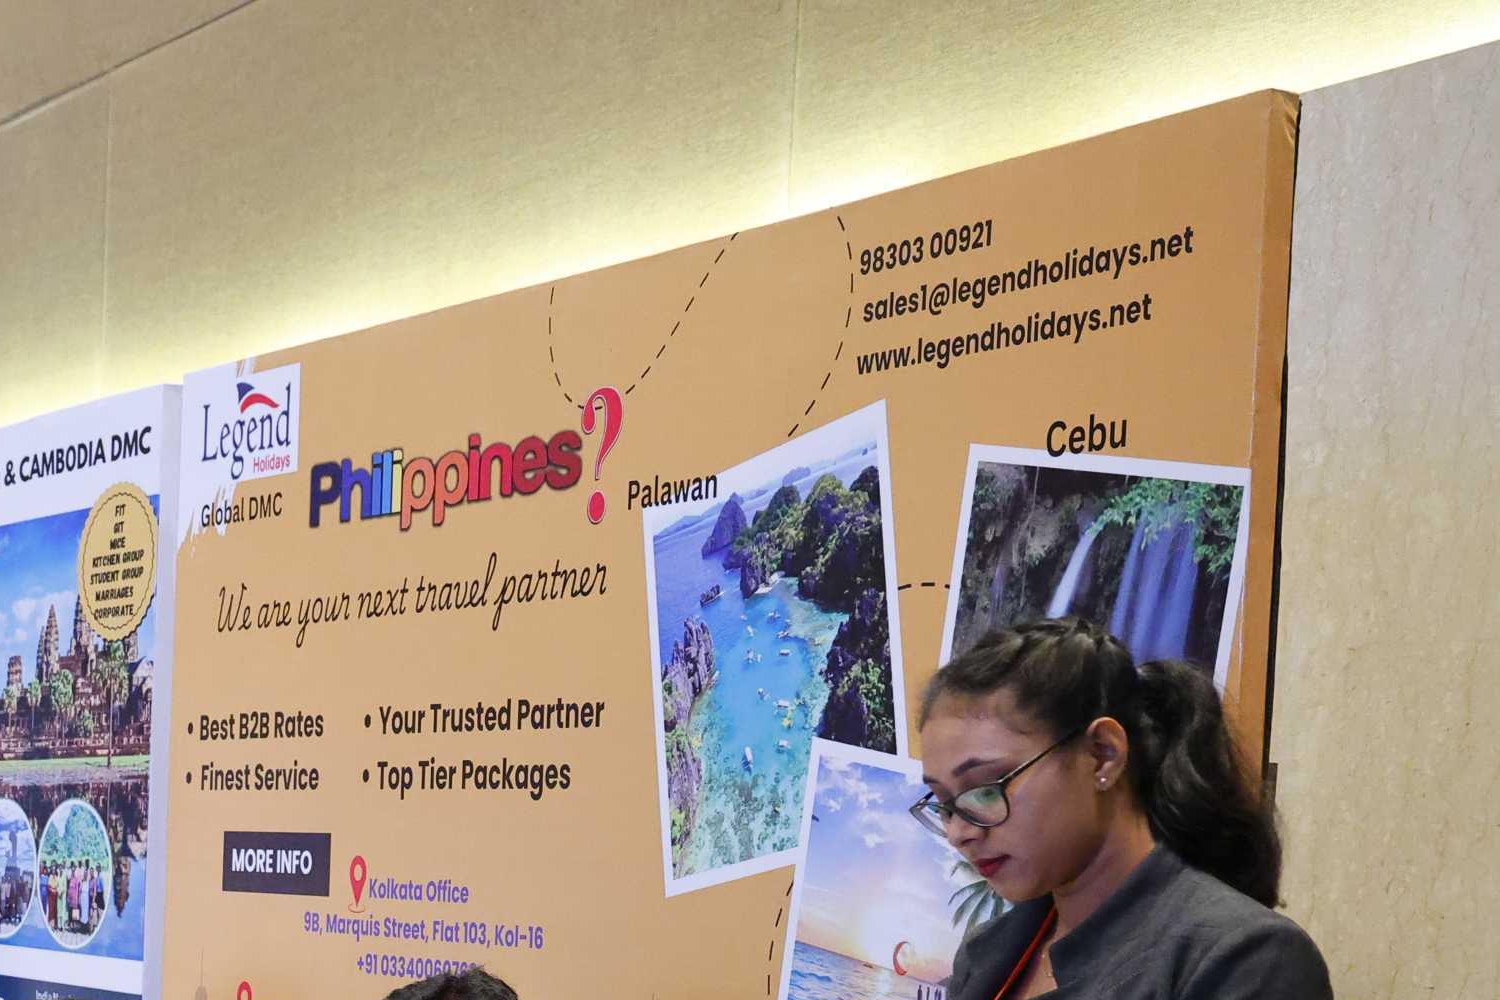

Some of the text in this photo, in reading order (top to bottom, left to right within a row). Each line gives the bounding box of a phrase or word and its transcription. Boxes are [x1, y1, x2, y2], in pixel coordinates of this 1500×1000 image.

[860, 220, 993, 275] 98303 00921
[863, 226, 1193, 322] sales1@legendholidays.net
[857, 293, 1152, 375] www.legendholidays.net
[202, 382, 291, 480] Legend
[1046, 414, 1127, 457] Cebu
[4, 460, 16, 486] &
[19, 438, 106, 482] CAMBODIA
[111, 426, 152, 462] DMC
[253, 454, 290, 473] Holidays
[627, 472, 718, 510] Palawan
[115, 504, 126, 517] FIT
[201, 492, 282, 527] Global DMC
[90, 566, 144, 585] STUDENT GROUP
[92, 549, 144, 568] KITCHEN GROUP
[95, 586, 134, 601] MARRIAGES
[217, 552, 607, 648] We are your next travel partner
[94, 604, 134, 620] CORPORATE
[200, 710, 324, 741] Best B2B Rates
[379, 698, 605, 735] Your Trusted Partner
[200, 759, 319, 791] Finest Service
[377, 757, 571, 801] Top Tier Packages
[231, 848, 313, 875] MORE INFO
[369, 878, 469, 904] Kolkata Office
[304, 912, 543, 949] 9B, Marquis Street, Flat 103, Kol-16
[357, 953, 377, 975] +91
